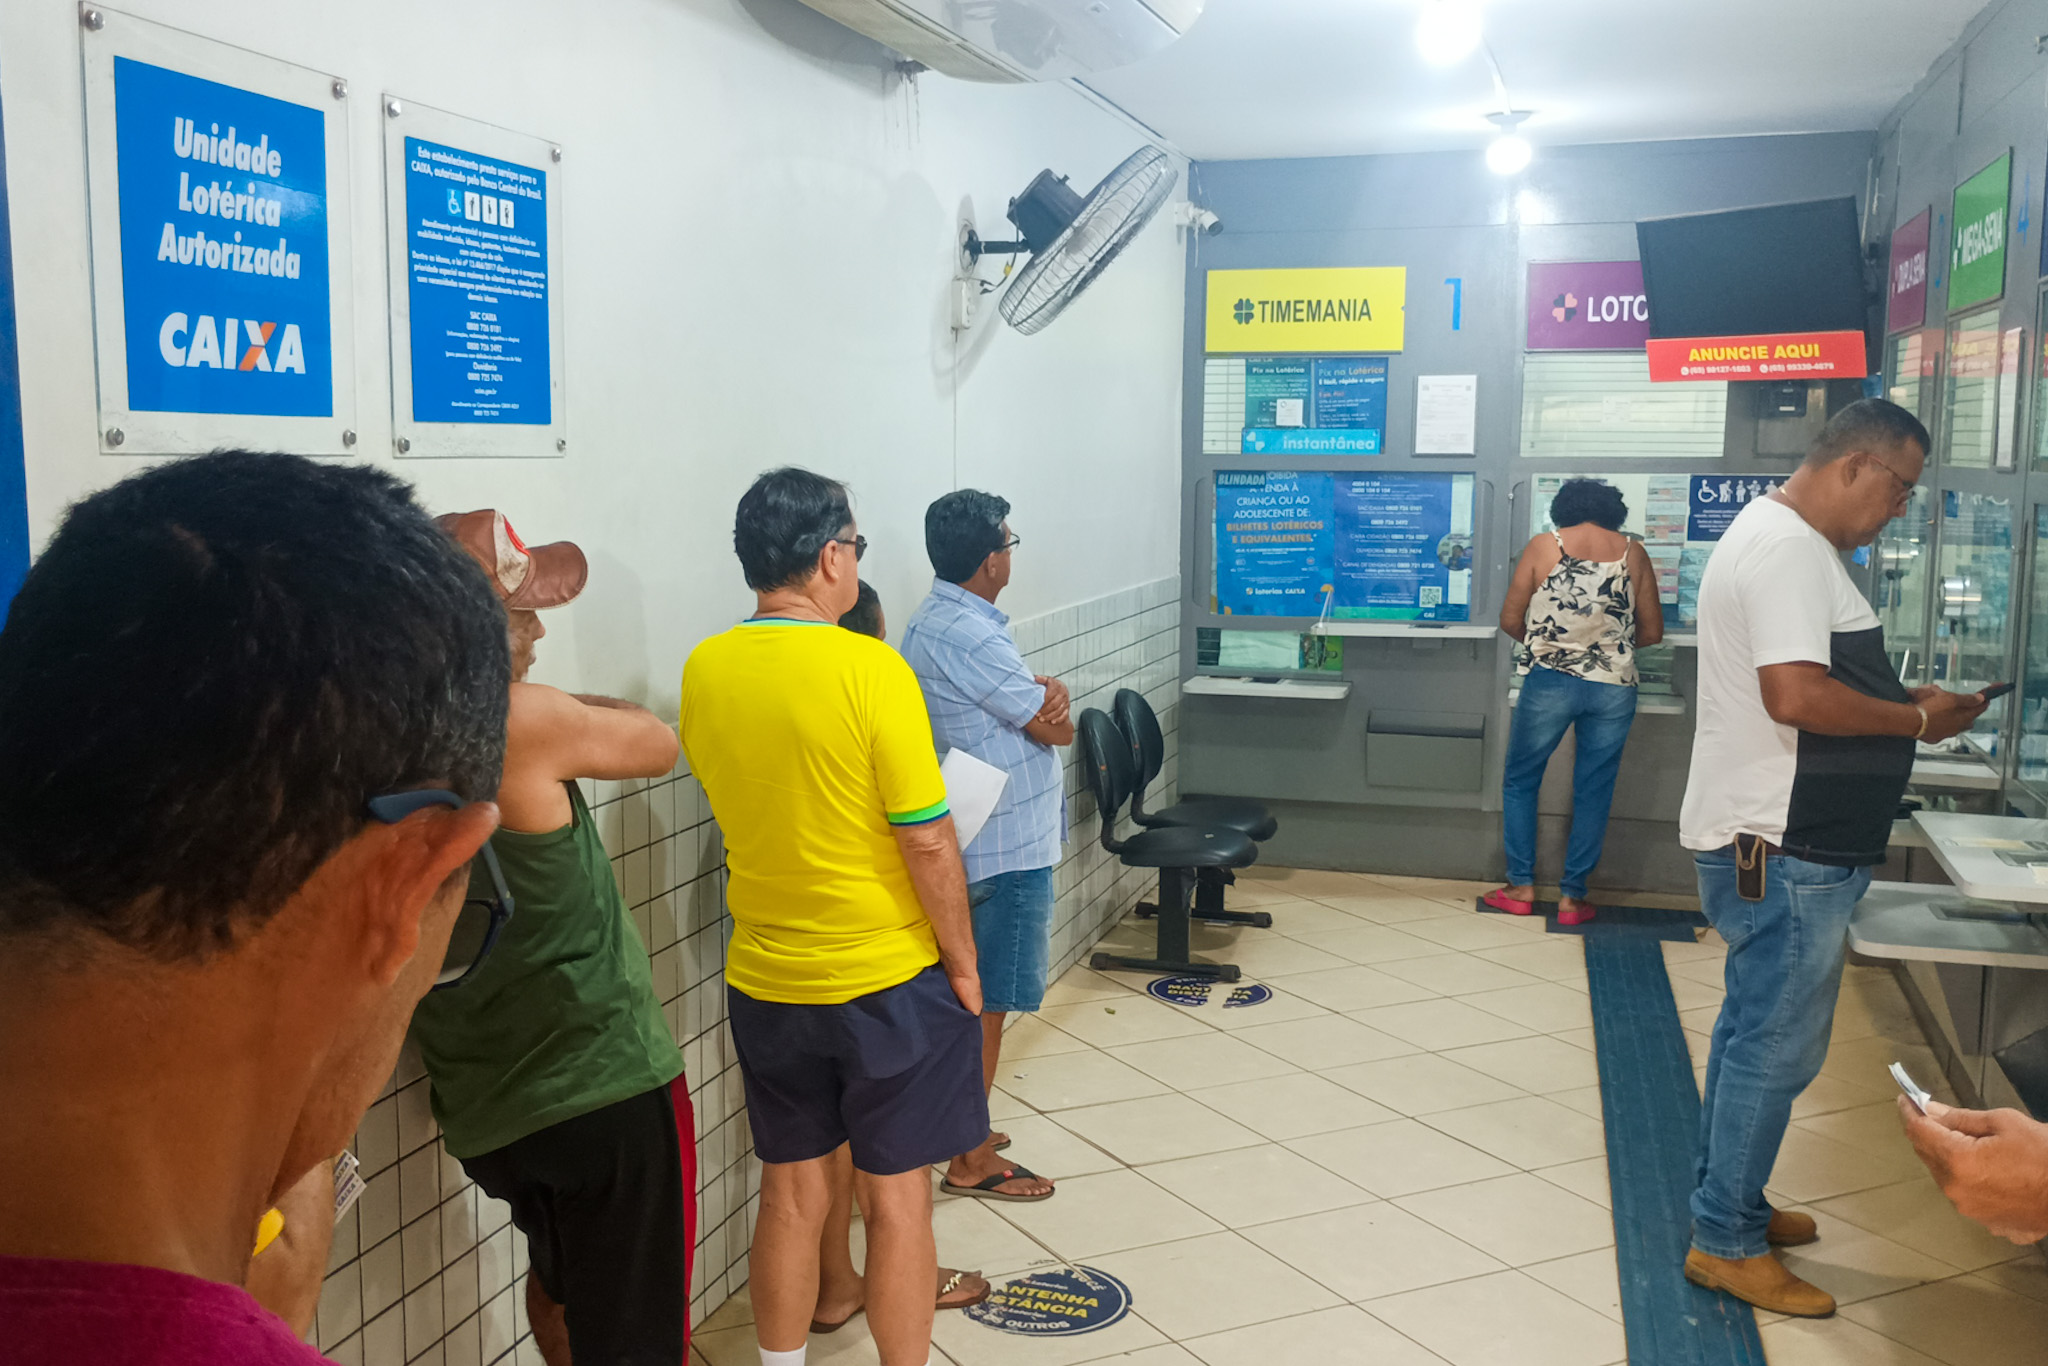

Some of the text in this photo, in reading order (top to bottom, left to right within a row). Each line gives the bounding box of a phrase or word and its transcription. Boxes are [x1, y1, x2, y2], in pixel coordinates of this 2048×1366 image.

[174, 117, 281, 178] Unidade
[178, 171, 280, 227] Lotérica
[1962, 207, 2003, 266] MEGA-SENA
[157, 222, 300, 280] Autorizada
[1258, 299, 1372, 323] TIMEMANIA
[1444, 278, 1462, 331] 1
[159, 311, 306, 375] CAIXA
[1688, 343, 1820, 362] ANUNCIE AQUI
[1319, 369, 1332, 377] Pix
[1348, 366, 1385, 376] Lotérica
[1283, 436, 1375, 450] instantânea
[1218, 474, 1266, 485] BLINDADA
[1261, 482, 1299, 492] ENDA À
[1237, 495, 1310, 506] CRIANÇA OU AO
[1233, 508, 1295, 519] ADOLESCENTE
[1226, 520, 1323, 531] BILHETES LOTÉRICOS
[1232, 536, 1238, 544] E
[1005, 1320, 1071, 1330] OUTROS
